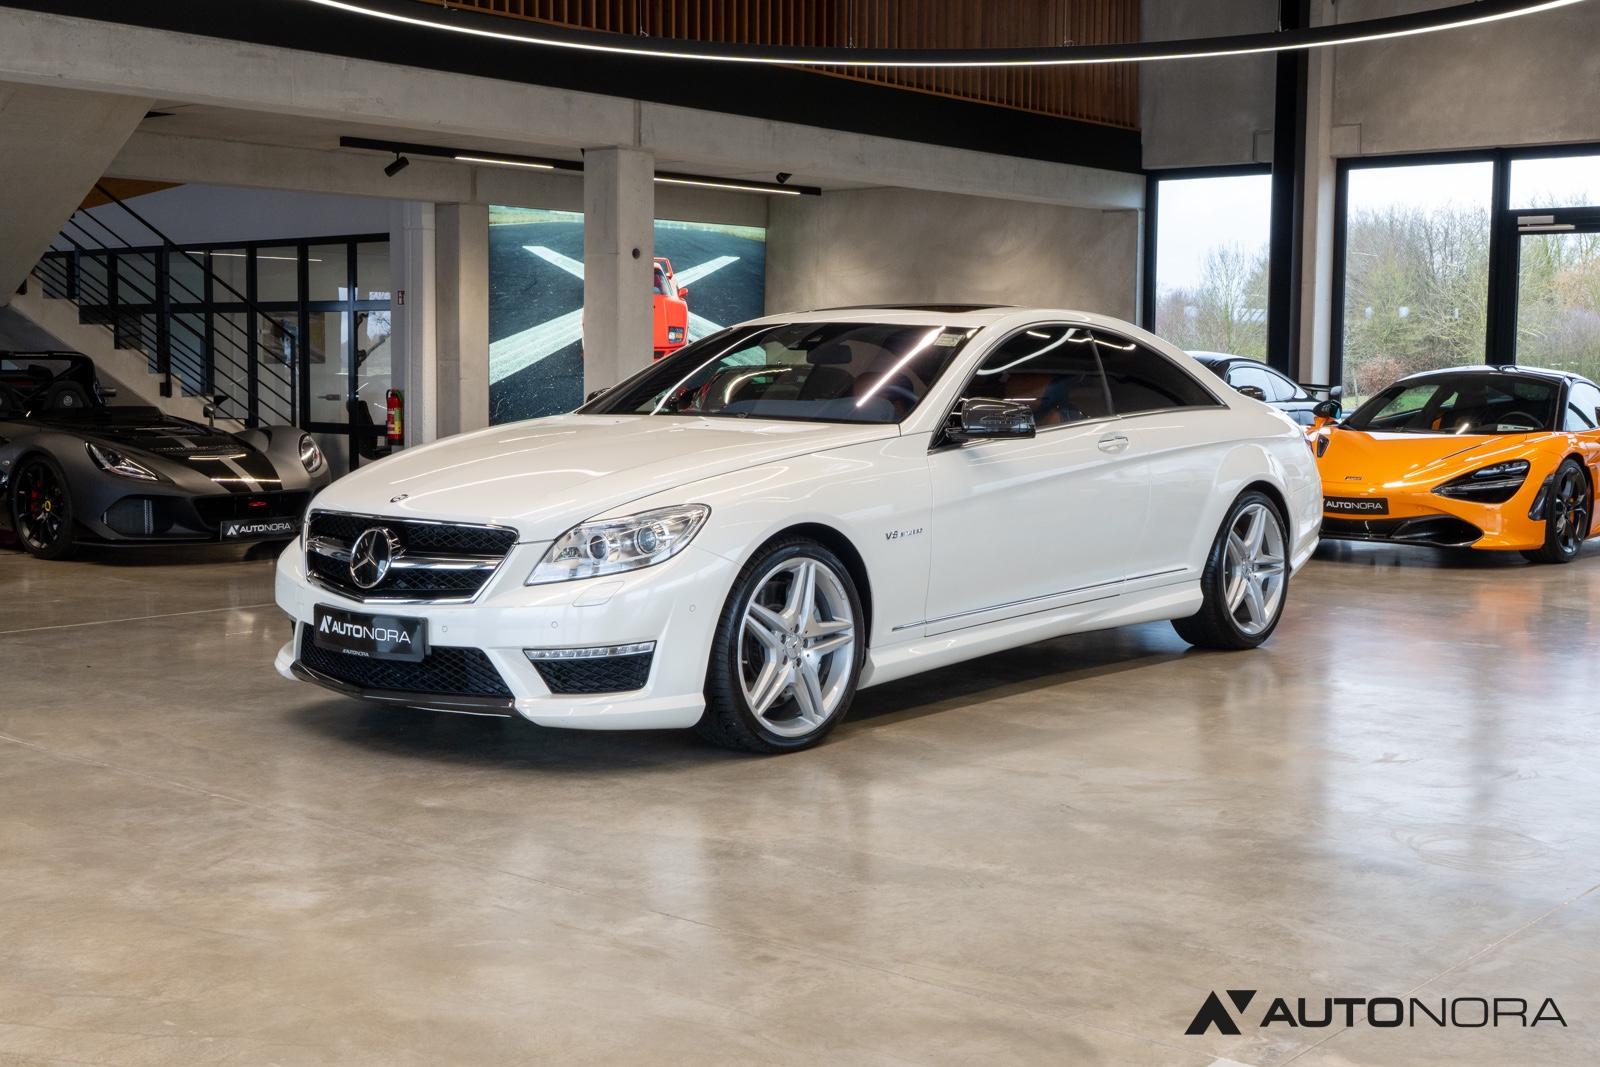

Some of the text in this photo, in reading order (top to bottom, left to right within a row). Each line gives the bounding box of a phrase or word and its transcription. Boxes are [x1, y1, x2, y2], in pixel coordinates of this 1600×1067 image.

[1326, 501, 1383, 510] AUTONORA
[239, 522, 291, 533] AUTONORA
[331, 620, 411, 644] AUTONORA
